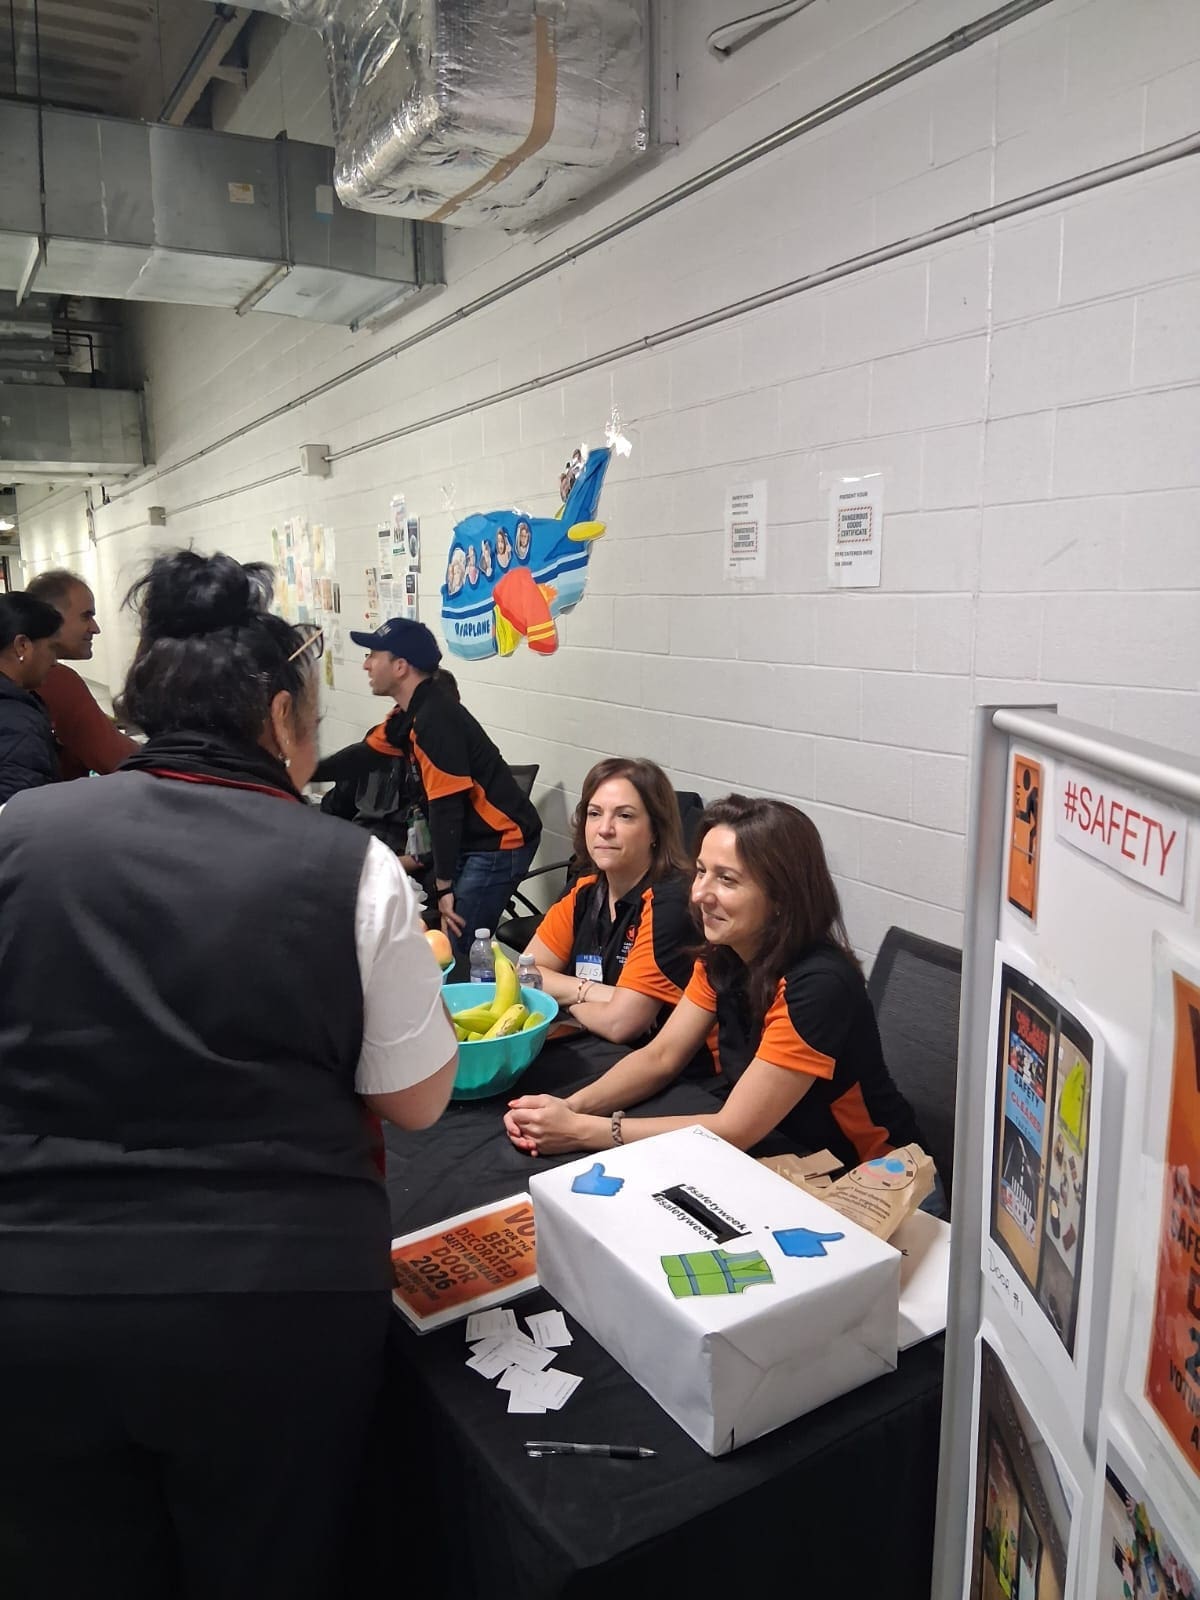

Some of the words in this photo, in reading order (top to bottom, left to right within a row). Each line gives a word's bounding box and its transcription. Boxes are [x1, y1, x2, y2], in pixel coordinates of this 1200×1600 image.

[1064, 780, 1177, 877] #SAFETY
[1014, 1072, 1040, 1108] SAFETY
[653, 1196, 715, 1241] #safetyweek
[685, 1185, 748, 1230] #safetyweek
[441, 1233, 466, 1257] SAFETY
[455, 1227, 518, 1279] DECORATED
[481, 1231, 524, 1260] BEST
[501, 1228, 519, 1242] FOR
[515, 1239, 533, 1252] THE
[410, 1255, 458, 1290] 2026
[431, 1245, 479, 1284] DOOR
